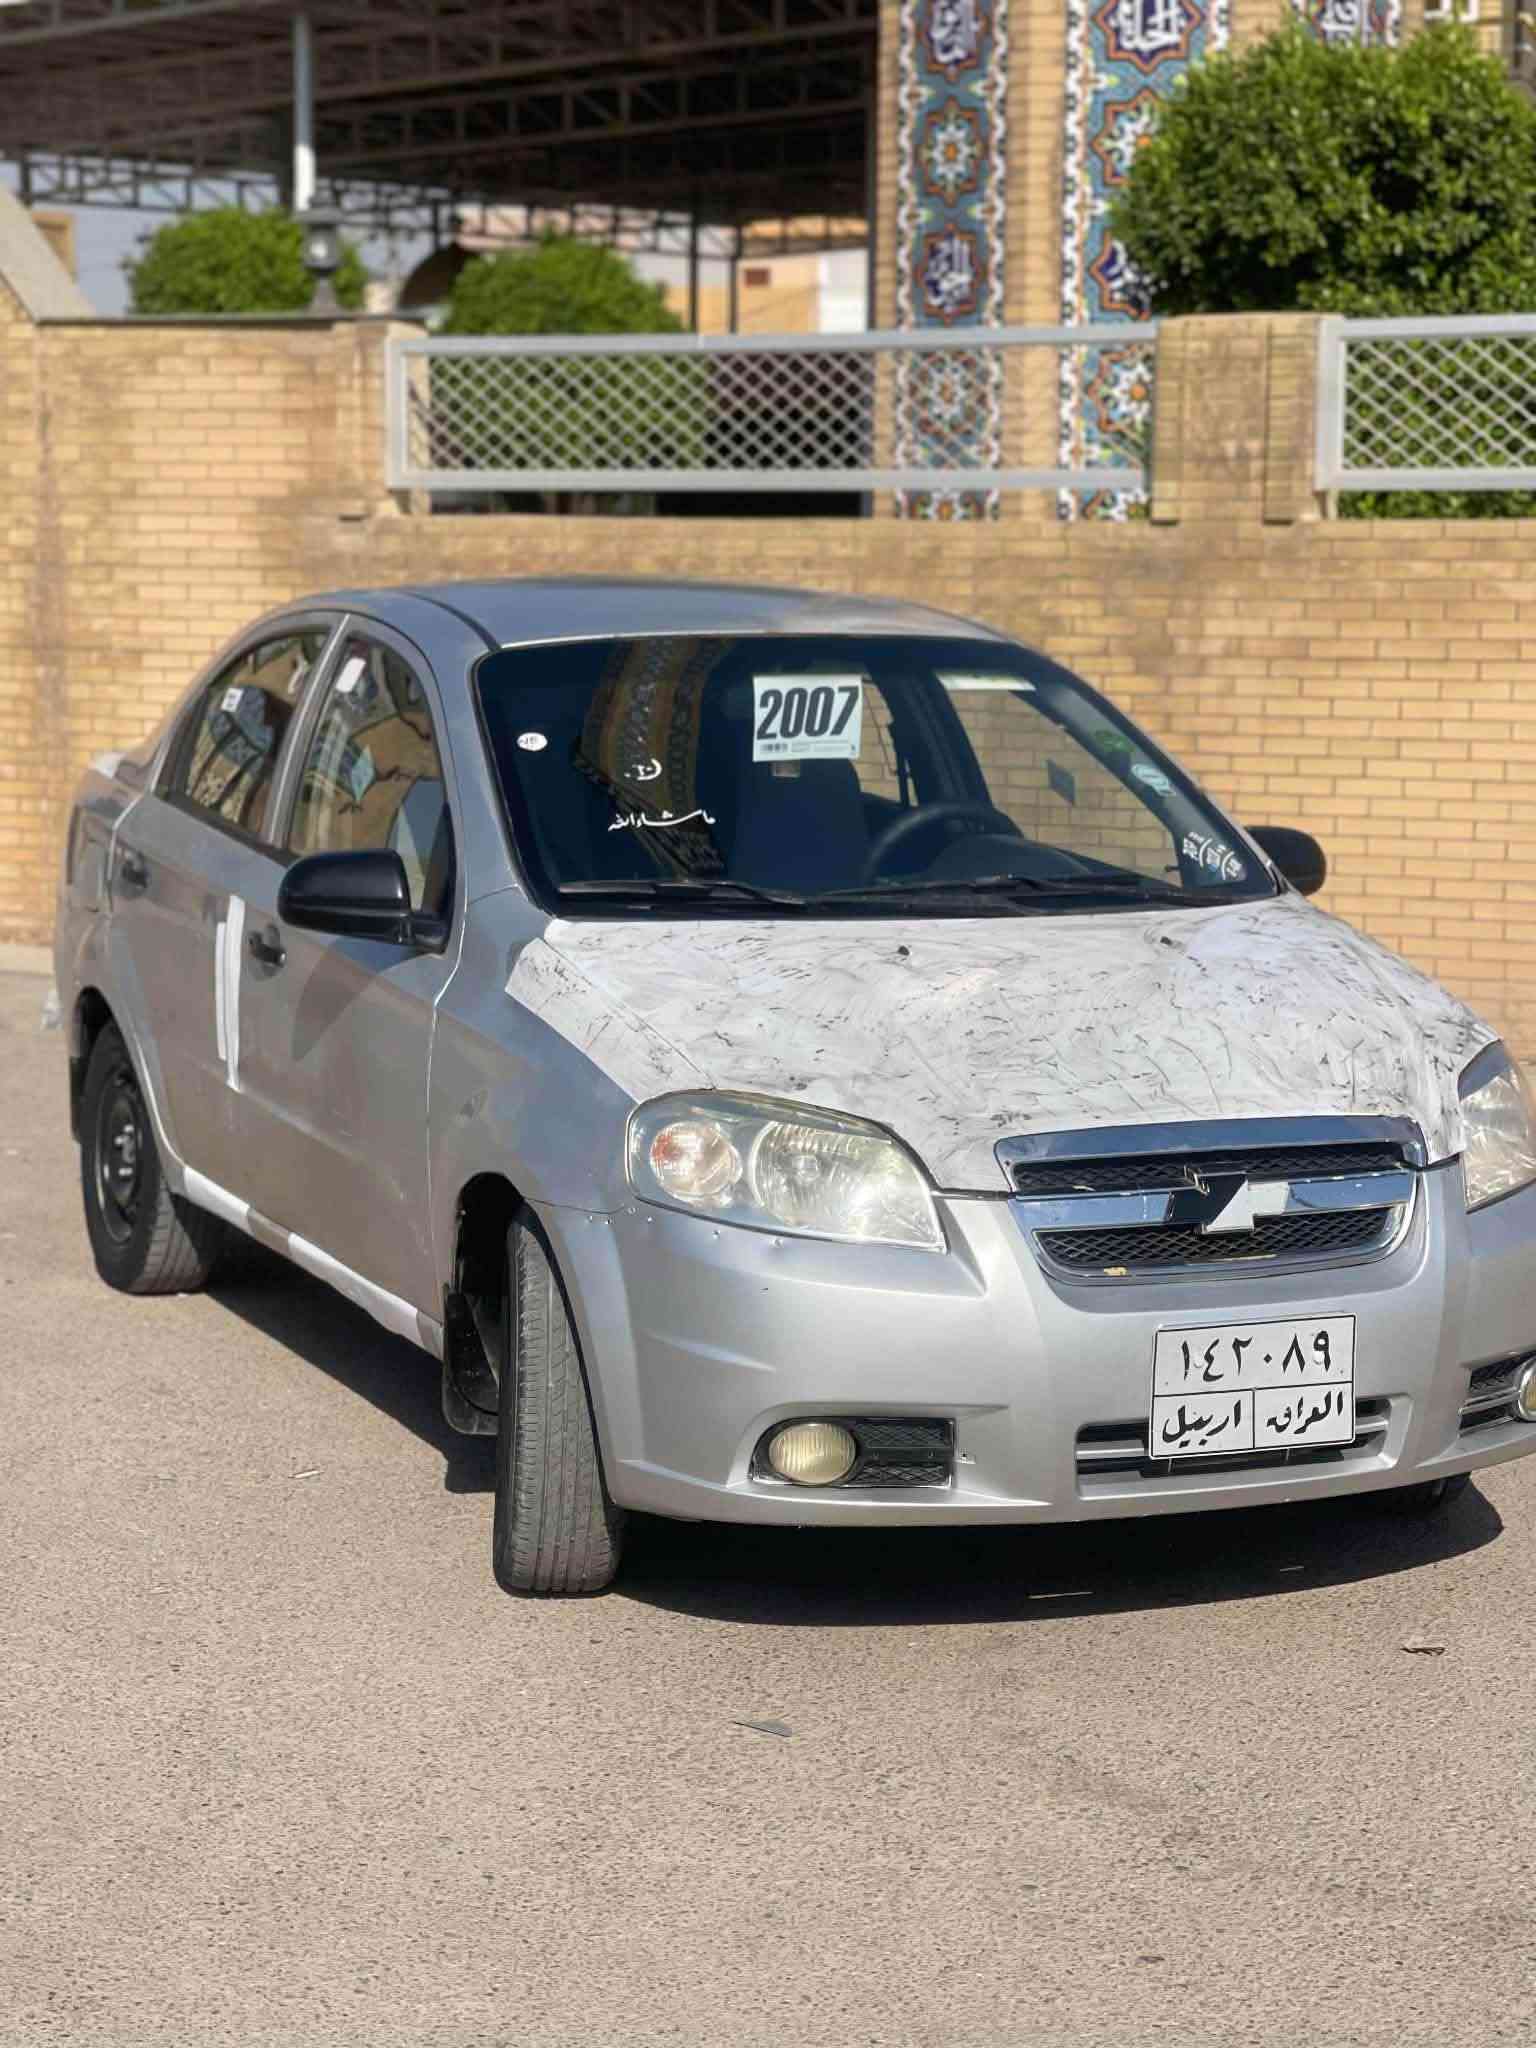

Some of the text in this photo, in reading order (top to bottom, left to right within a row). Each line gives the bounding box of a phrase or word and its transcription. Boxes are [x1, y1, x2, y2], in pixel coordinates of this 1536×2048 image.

[757, 686, 859, 740] 2007
[1180, 1329, 1332, 1383] ١٤٢٠٨٩
[1266, 1390, 1344, 1435] العراق
